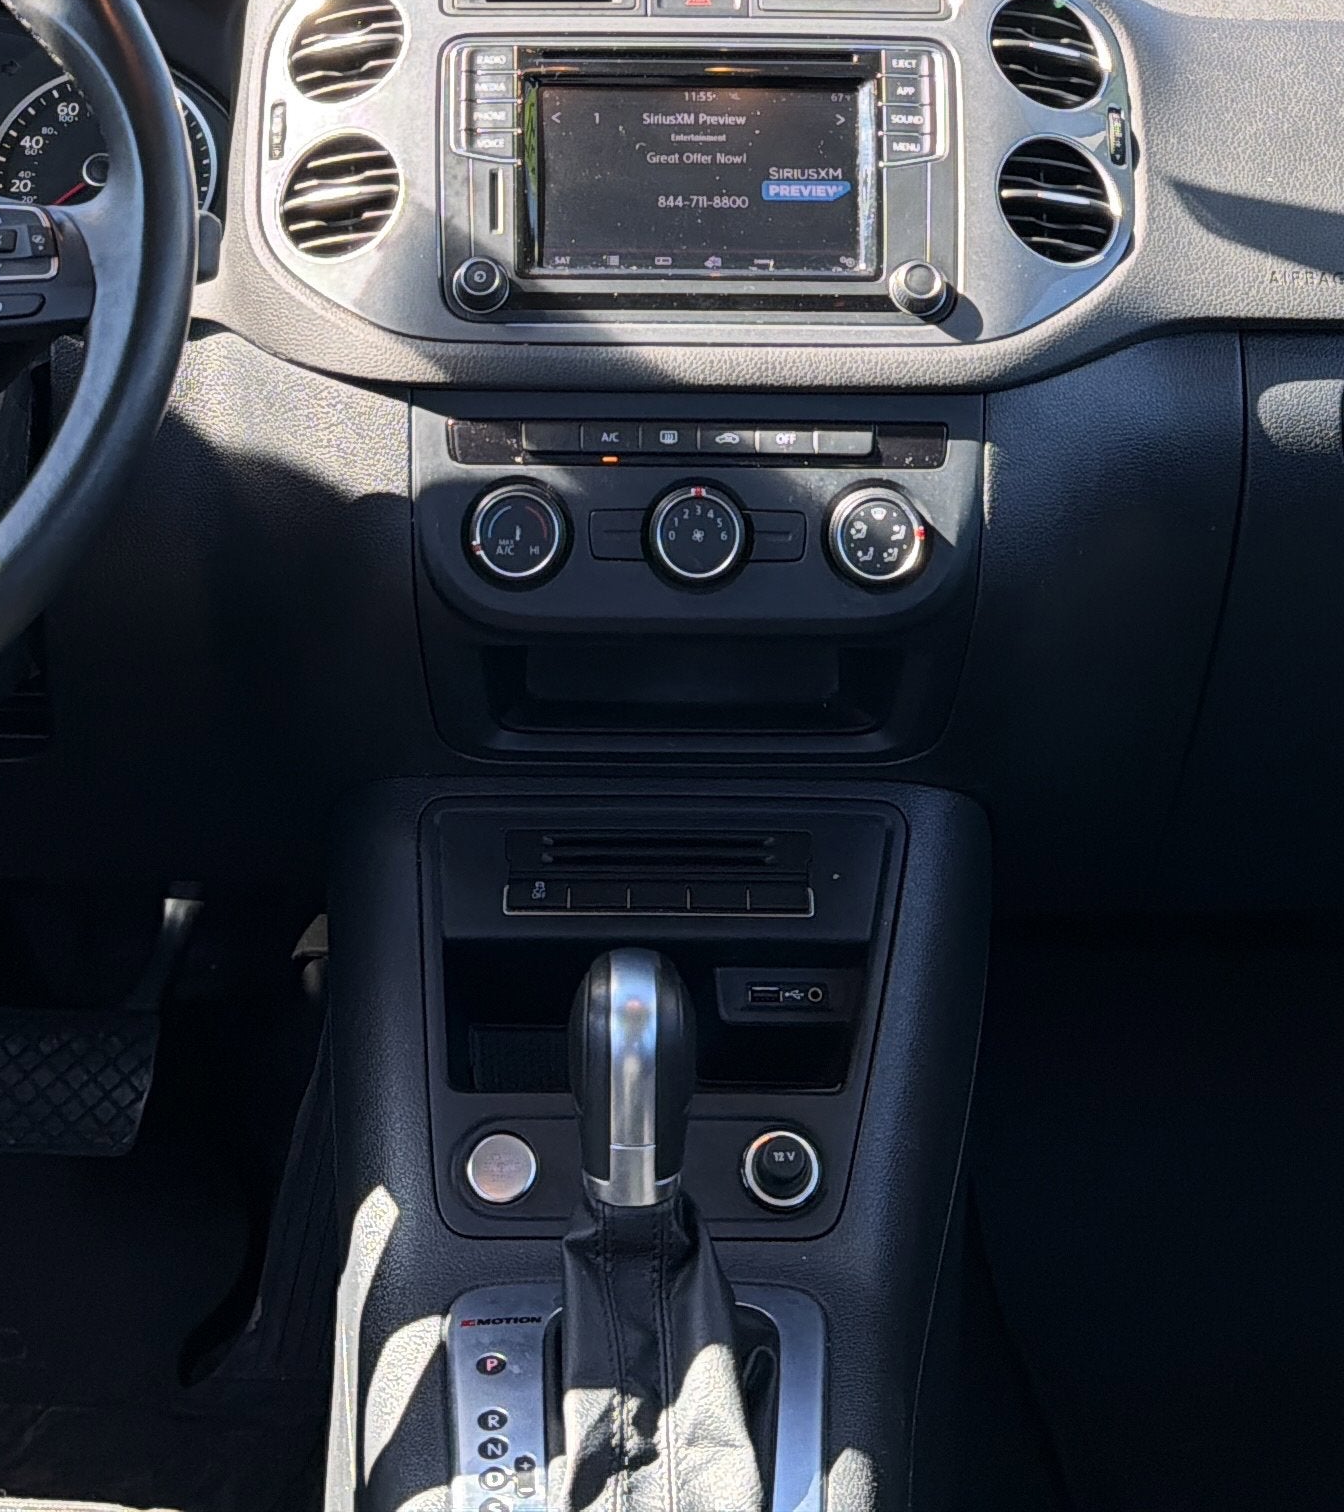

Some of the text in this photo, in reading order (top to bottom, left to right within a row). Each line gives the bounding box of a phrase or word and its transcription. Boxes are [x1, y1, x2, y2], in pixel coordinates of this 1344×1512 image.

[476, 55, 507, 65] RADIO
[891, 59, 917, 68] EJECT
[896, 86, 915, 95] APP
[57, 102, 79, 116] 60
[58, 115, 74, 123] 100
[594, 113, 600, 124] 1
[642, 113, 746, 126] SiriusXM Preview
[890, 114, 924, 125] SOUND
[41, 127, 54, 135] 80
[20, 136, 43, 148] 40
[670, 133, 727, 142] Entertainment
[892, 142, 921, 152] MENU
[646, 152, 747, 164] Great Offer Now!
[768, 167, 843, 180] SIRIUSXM
[10, 179, 32, 192] 20
[768, 184, 844, 197] PREVIEW
[21, 195, 34, 204] 20
[657, 196, 749, 209] 844-711-8800
[554, 255, 571, 265] SAT
[1269, 271, 1344, 285] AIRBAG
[601, 432, 619, 443] A/C
[775, 432, 796, 445] OFF
[682, 508, 690, 519] 2
[695, 505, 702, 516] 3
[706, 508, 714, 519] 4
[674, 517, 679, 527] 1
[716, 517, 723, 528] 5
[668, 530, 676, 541] 0
[720, 530, 728, 541] 6
[496, 545, 515, 556] A/C
[529, 545, 540, 556] HI
[773, 1151, 795, 1162] 12 V
[486, 1358, 498, 1371] P
[487, 1414, 499, 1428] R
[487, 1443, 502, 1456] N
[486, 1472, 504, 1485] D
